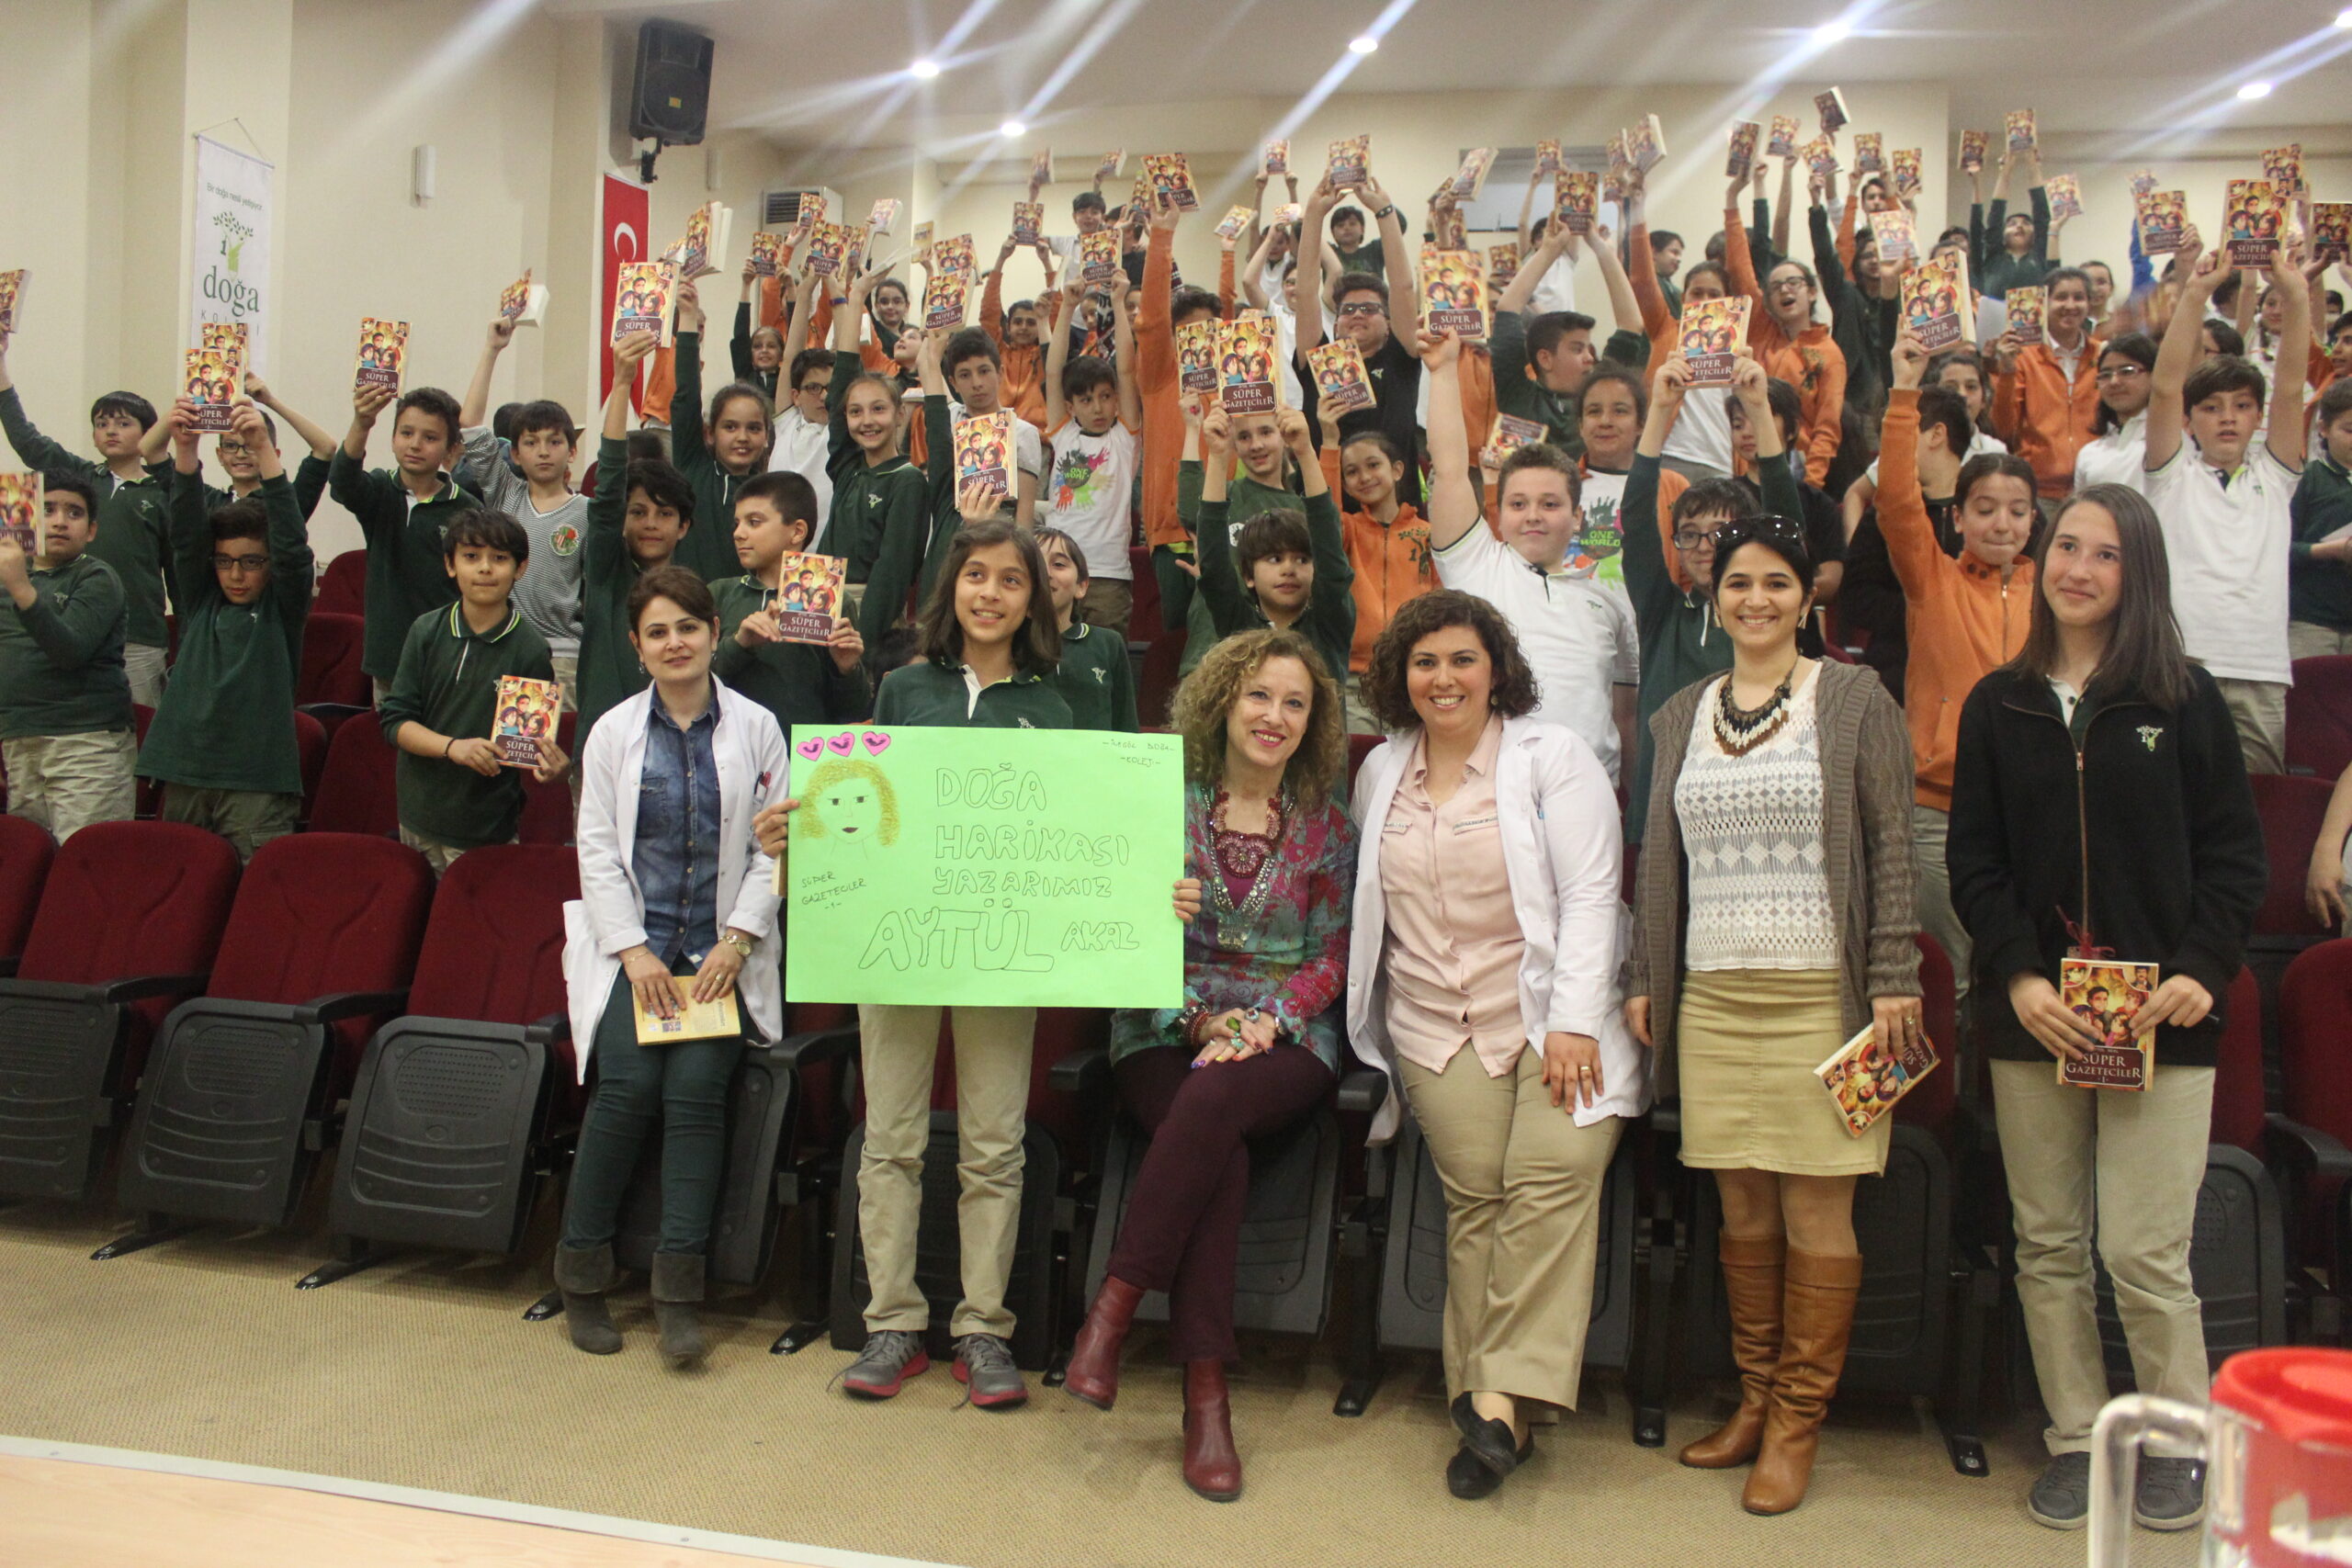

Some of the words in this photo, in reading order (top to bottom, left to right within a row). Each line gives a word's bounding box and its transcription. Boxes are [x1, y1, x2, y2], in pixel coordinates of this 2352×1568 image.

[202, 265, 259, 317] doğa
[1441, 315, 1471, 324] SÜPER
[625, 321, 651, 331] SÜPER
[1690, 359, 1722, 369] SÜPER
[365, 372, 390, 382] SÜPER
[1188, 372, 1210, 382] SÜPER
[1232, 388, 1263, 400] SÜPER
[1589, 530, 1614, 540] ONE
[1580, 538, 1621, 547] WORLD
[791, 615, 820, 627] SÜPER
[505, 739, 535, 752] SÜPER
[936, 762, 1047, 811] DOĞA
[935, 820, 1130, 866] HARİKASI
[932, 866, 1113, 897] YAZARIMIZ
[857, 897, 1055, 973] AYTÜL
[2083, 1053, 2126, 1066] SÜPER
[2066, 1063, 2142, 1077] GAZETECİLER
